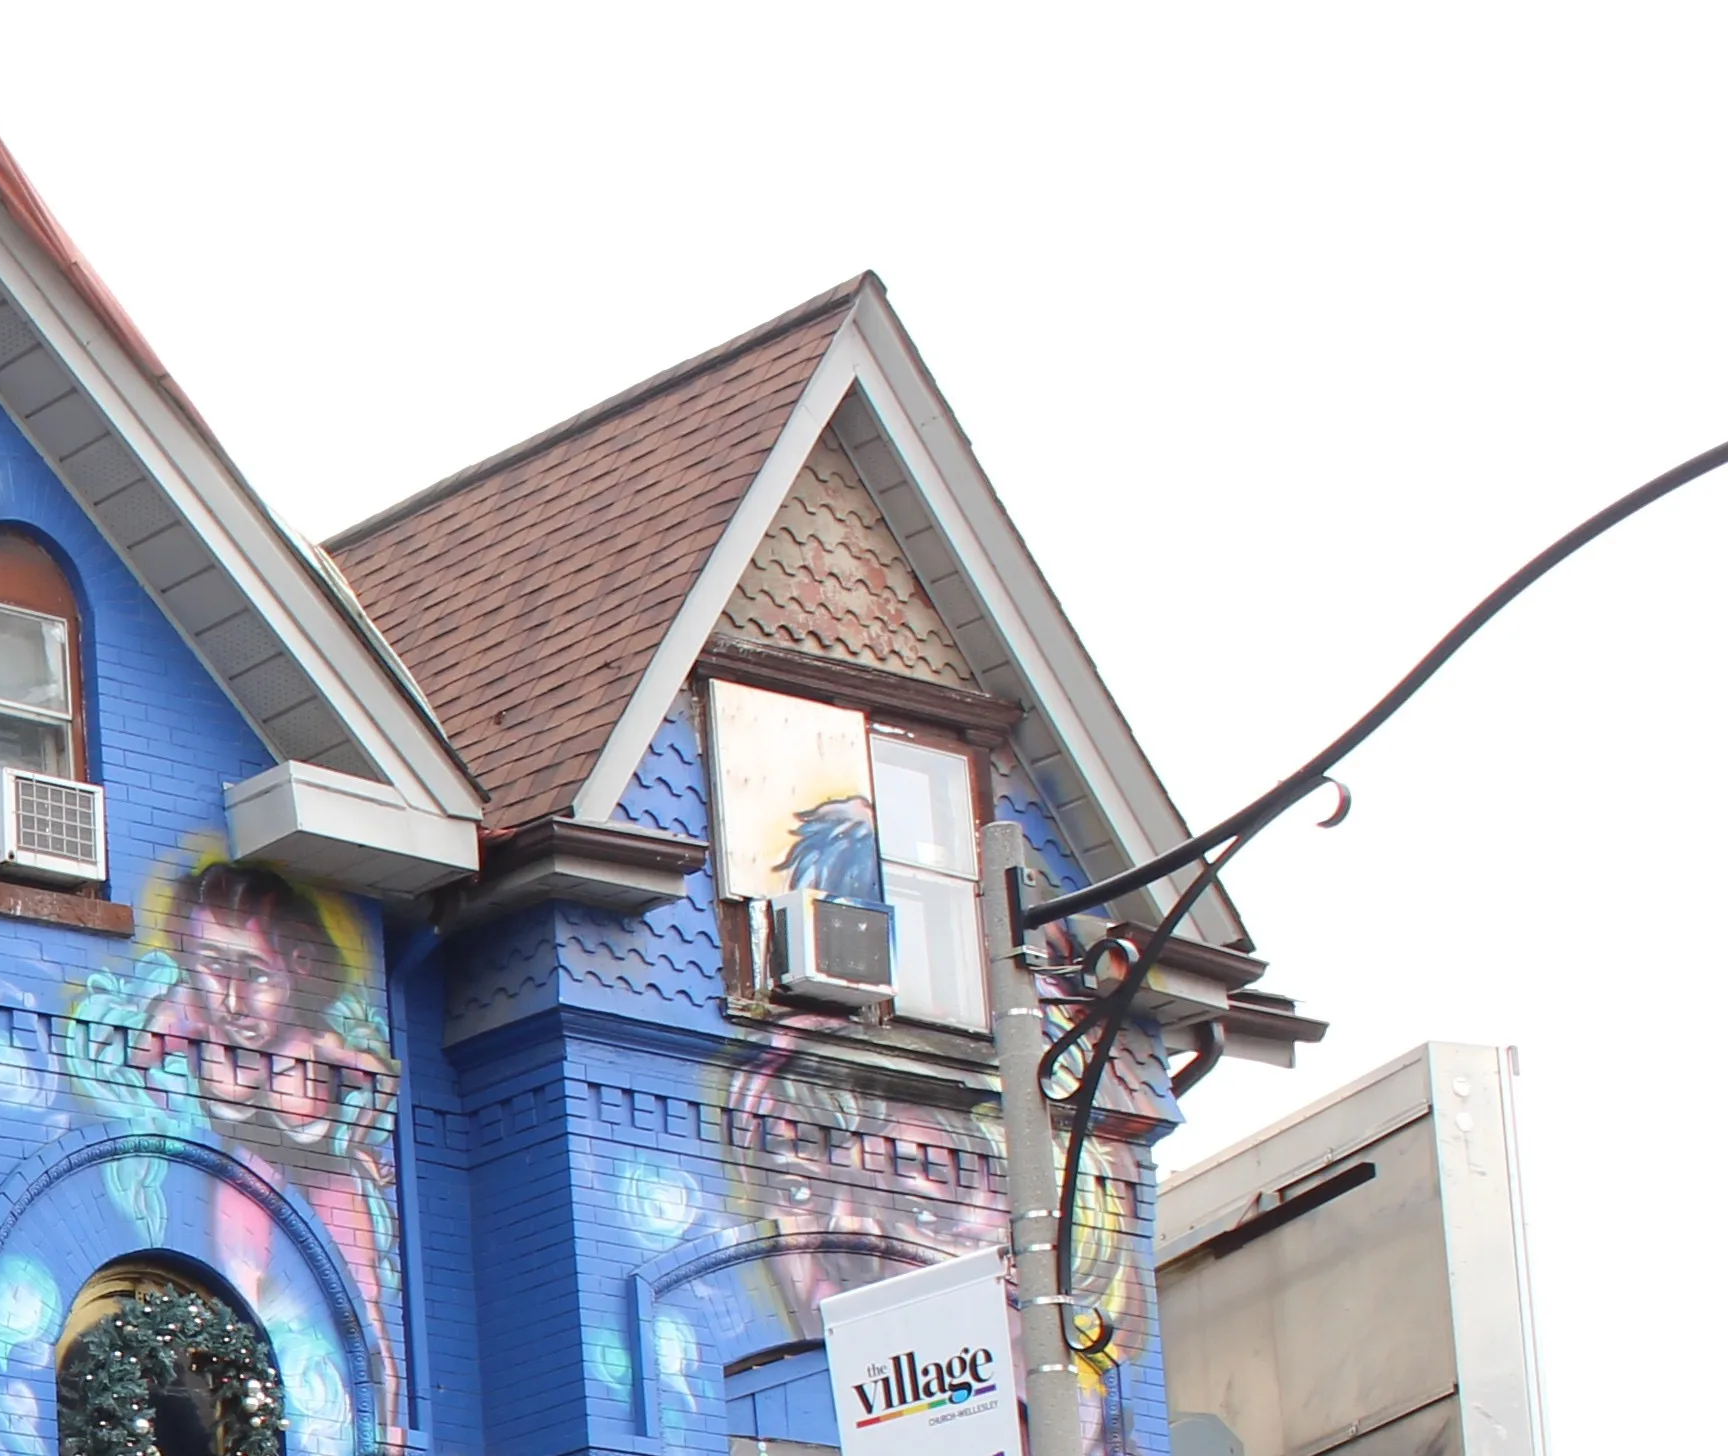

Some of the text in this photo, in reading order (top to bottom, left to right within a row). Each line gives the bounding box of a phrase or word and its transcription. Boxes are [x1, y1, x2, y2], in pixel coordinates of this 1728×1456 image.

[851, 1347, 996, 1415] village
[867, 1363, 888, 1379] the
[928, 1399, 999, 1427] CHURCH-WELLESLEY
